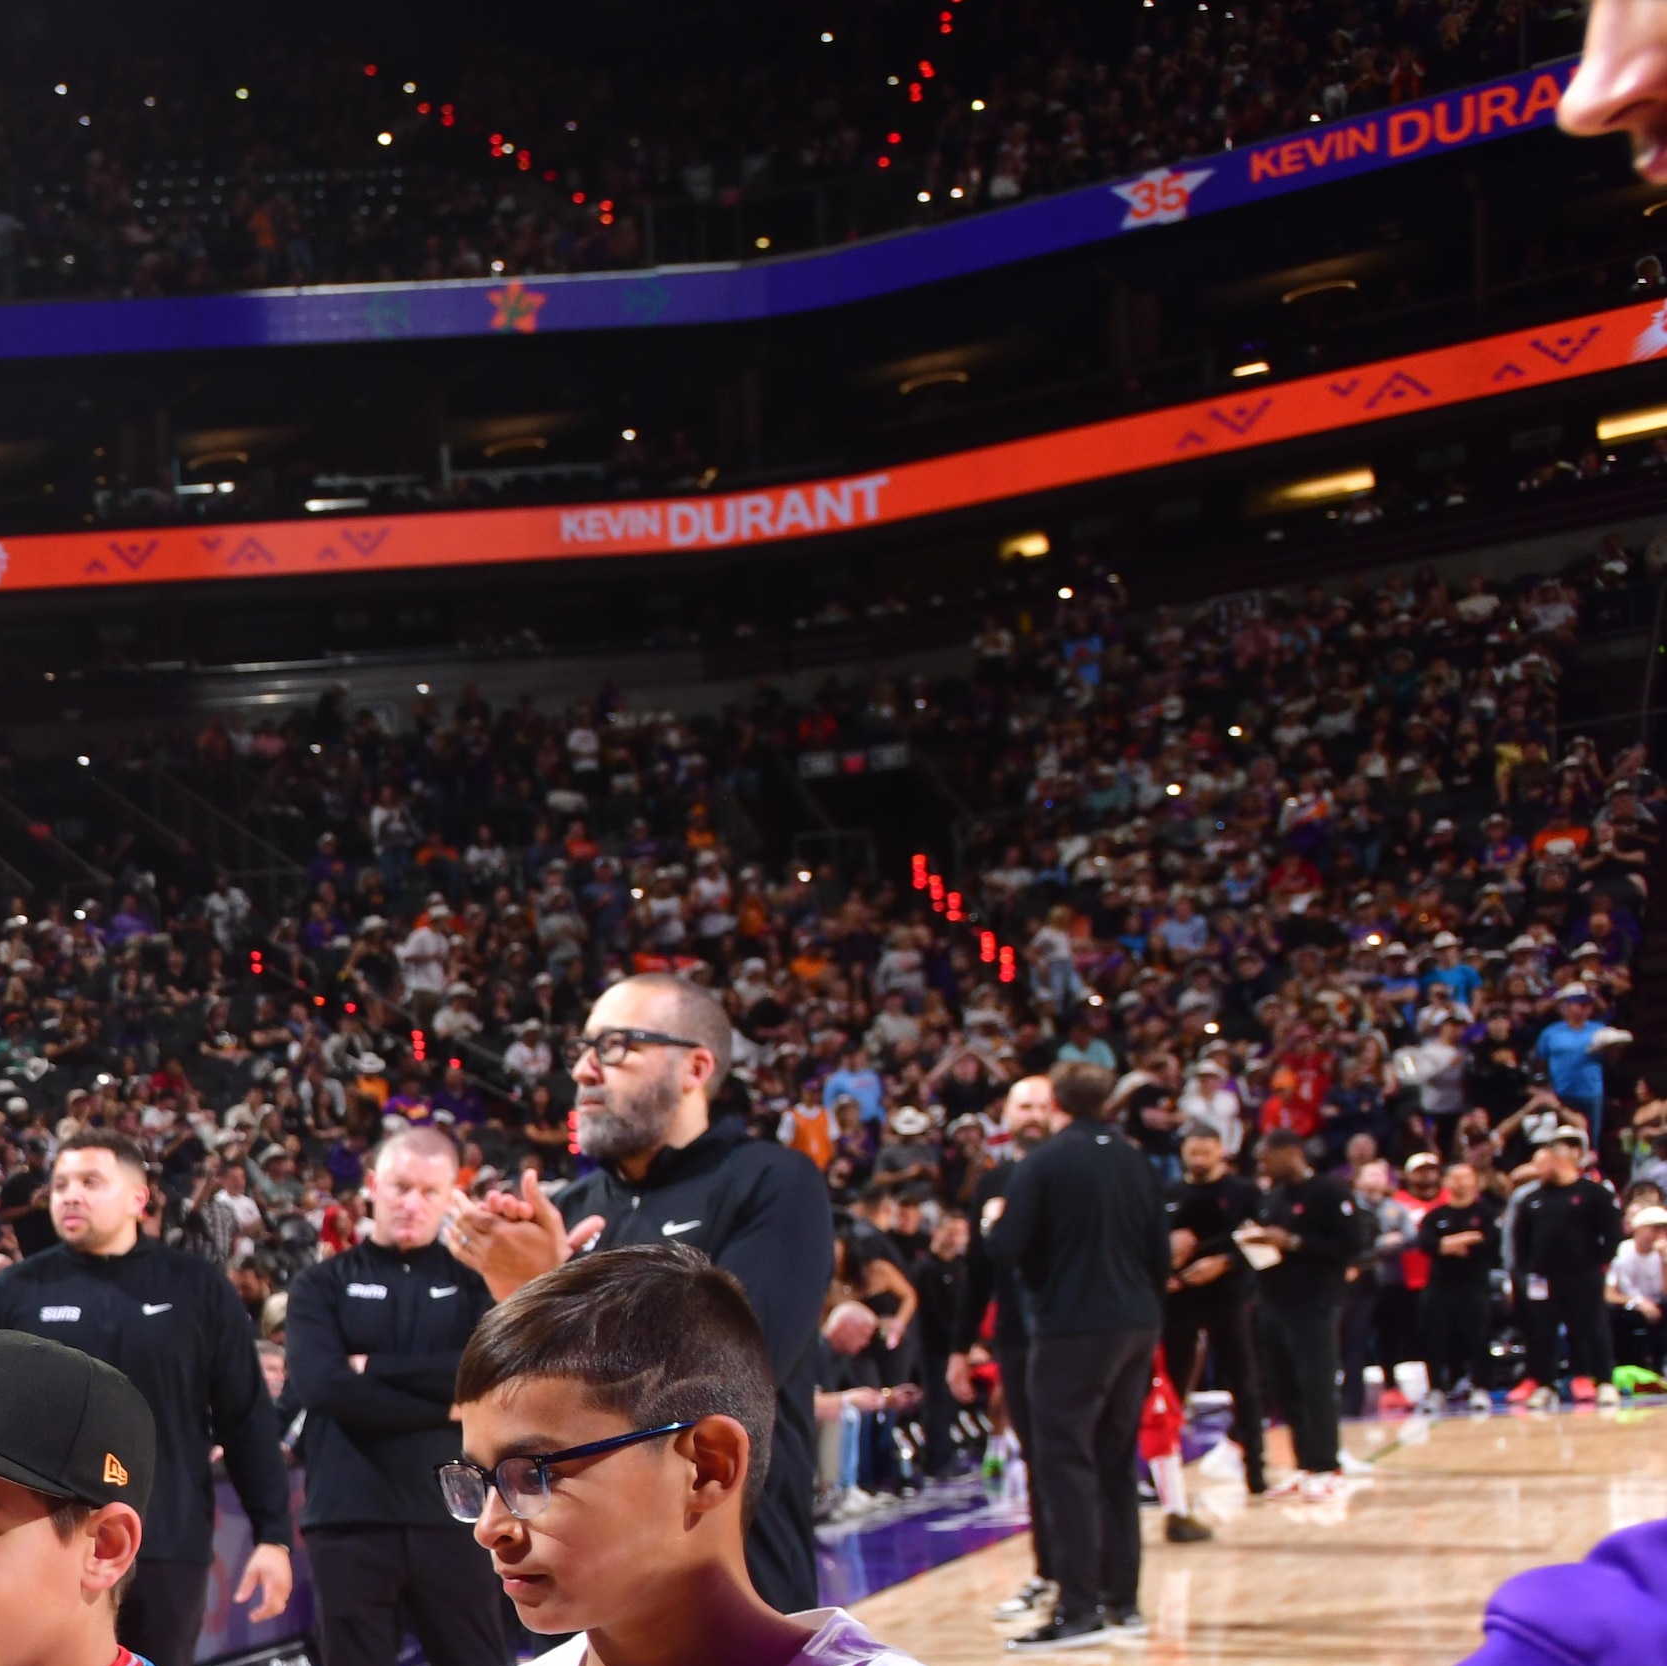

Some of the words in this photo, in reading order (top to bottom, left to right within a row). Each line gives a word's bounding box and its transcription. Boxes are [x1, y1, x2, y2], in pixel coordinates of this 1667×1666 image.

[1249, 121, 1378, 183] KEVIN
[1387, 66, 1579, 157] DURA
[1128, 172, 1190, 219] 35
[559, 508, 662, 543] KEVIN
[668, 473, 891, 547] DURANT
